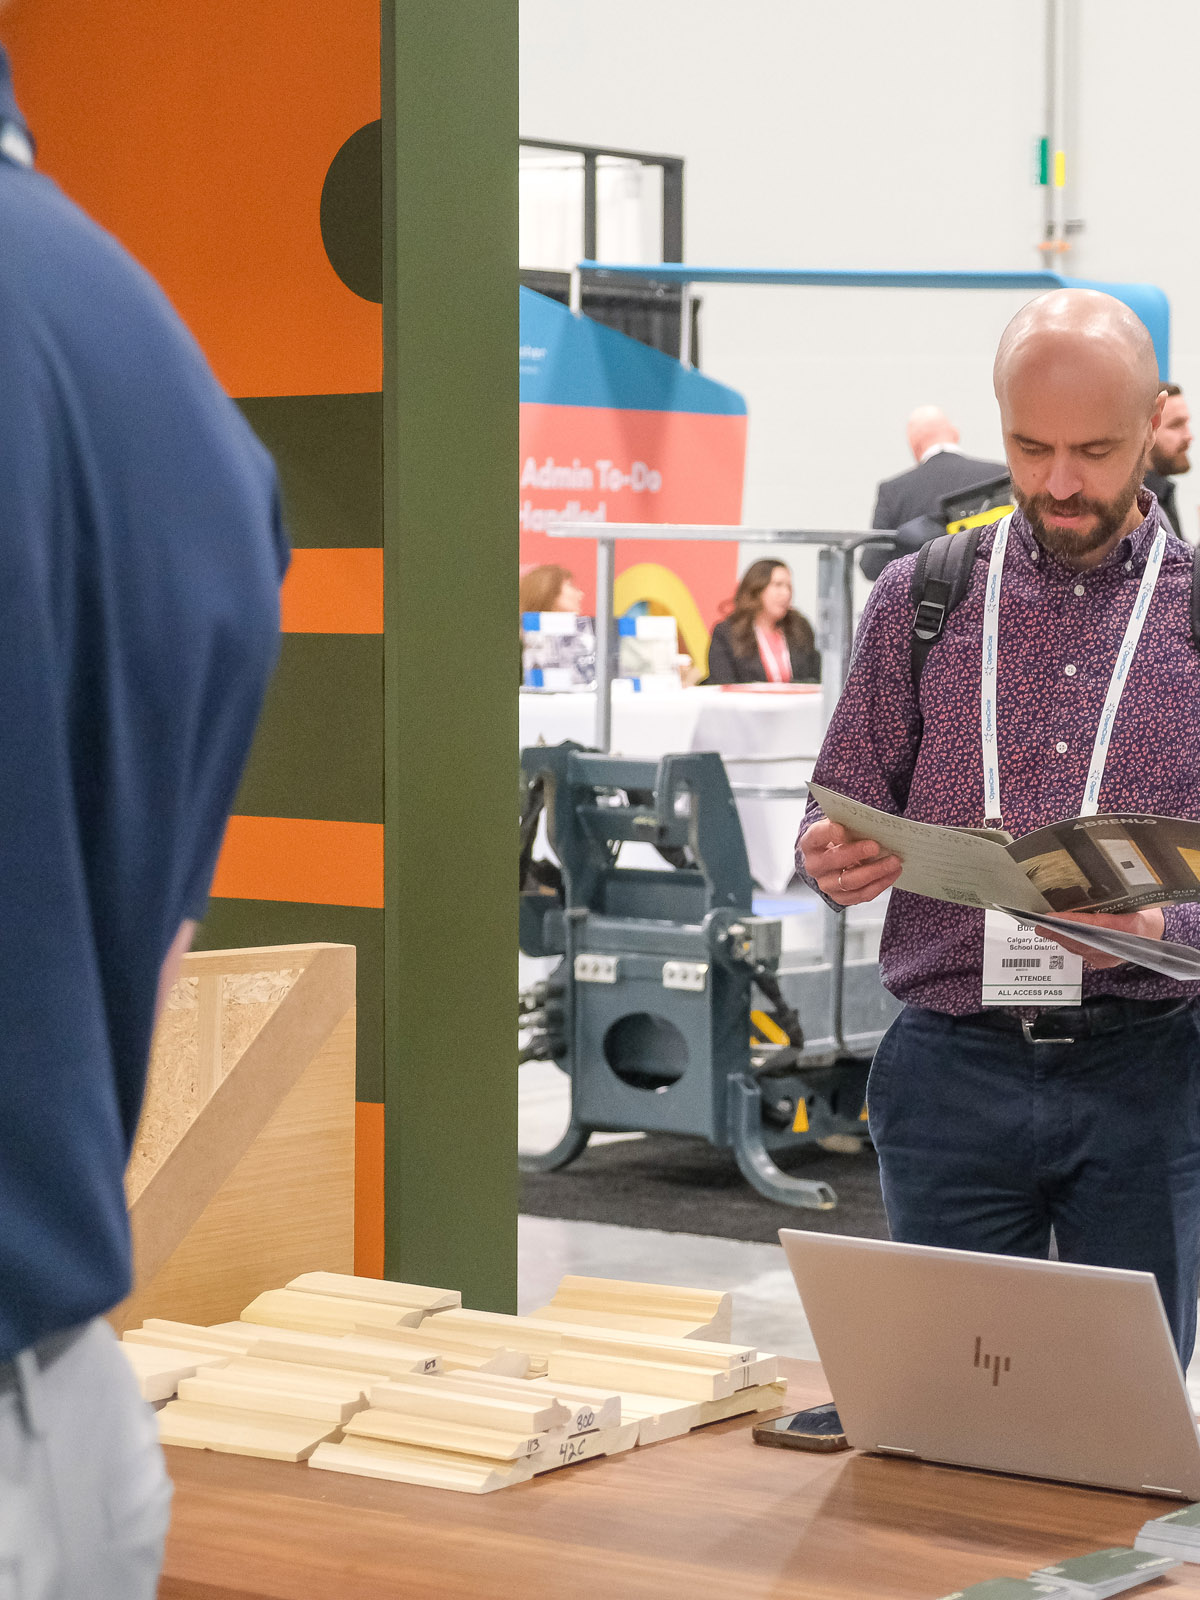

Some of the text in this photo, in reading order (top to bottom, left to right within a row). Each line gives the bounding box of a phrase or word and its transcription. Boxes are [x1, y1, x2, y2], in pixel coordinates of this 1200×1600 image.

[521, 457, 662, 492] Admin To-Do
[990, 574, 998, 602] OpenCircle
[1136, 592, 1148, 619] OpenCircle
[1117, 651, 1129, 680] OpenCircle
[1100, 714, 1111, 746] OpenCircle
[1084, 818, 1158, 828] BRENLO
[1094, 903, 1124, 914] YOUR
[974, 1336, 1011, 1387] hp
[576, 1411, 595, 1432] 800
[559, 1438, 586, 1464] 42C
